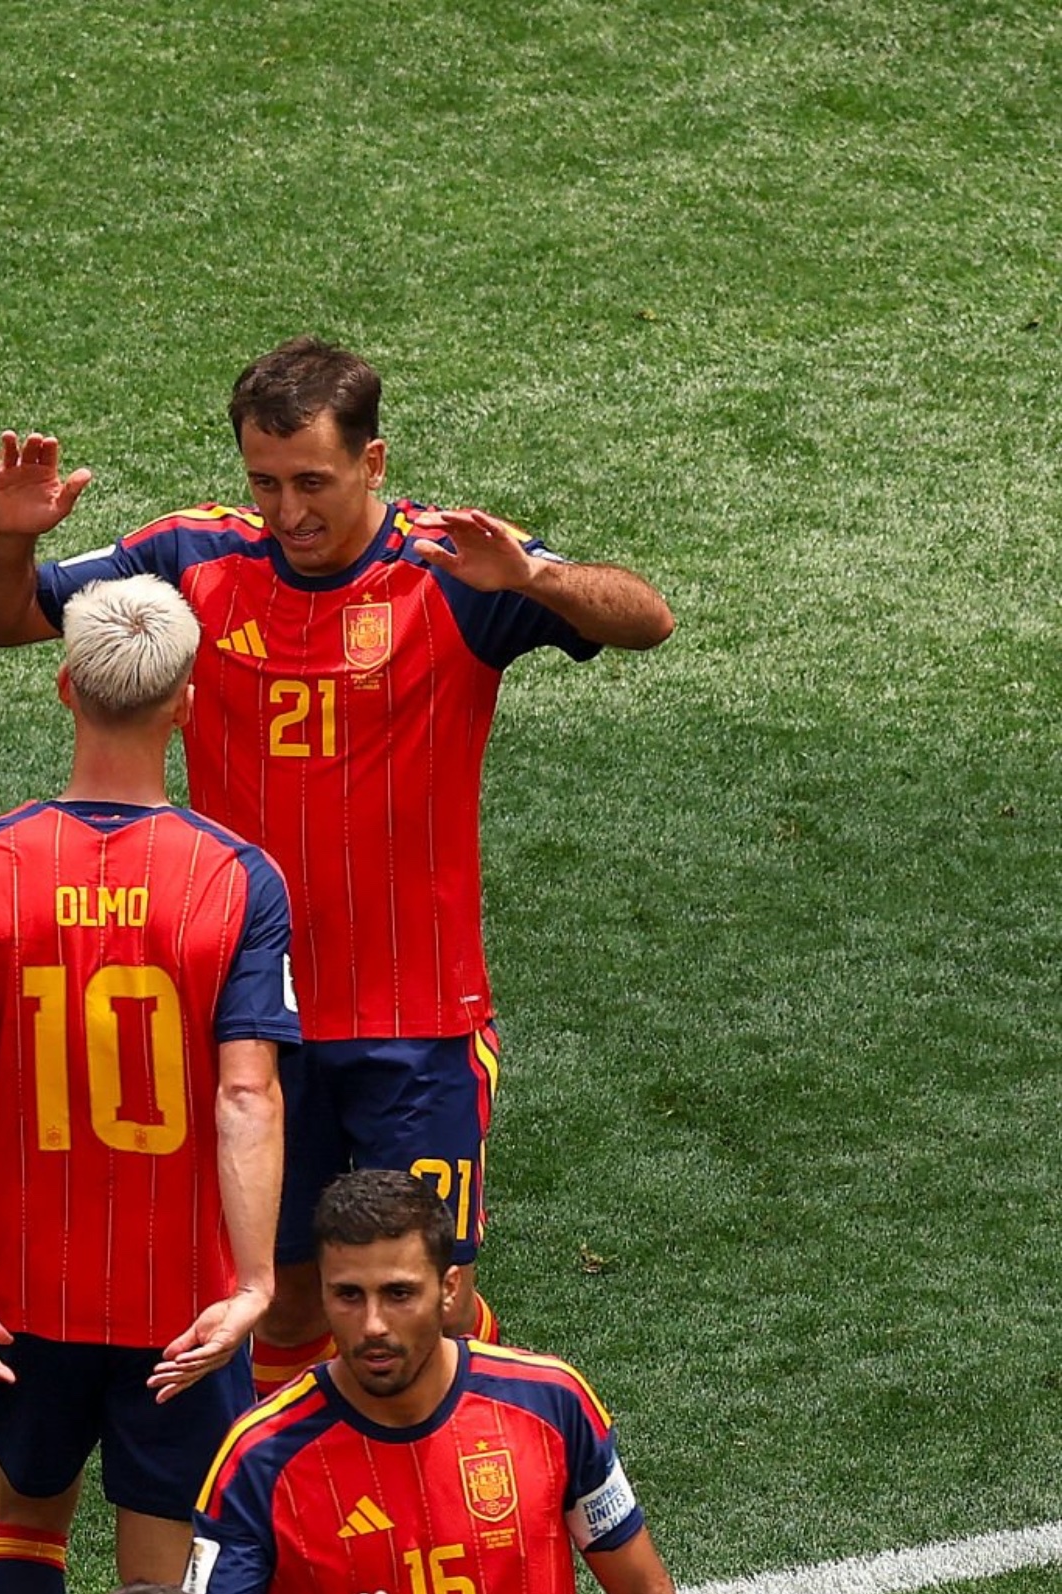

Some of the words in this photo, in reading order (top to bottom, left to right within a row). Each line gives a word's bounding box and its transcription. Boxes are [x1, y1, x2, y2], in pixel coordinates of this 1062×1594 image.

[270, 680, 336, 756] 21
[56, 886, 149, 927] OLMO
[23, 966, 187, 1155] 10
[410, 1159, 472, 1240] 21
[587, 1493, 627, 1525] UNITES
